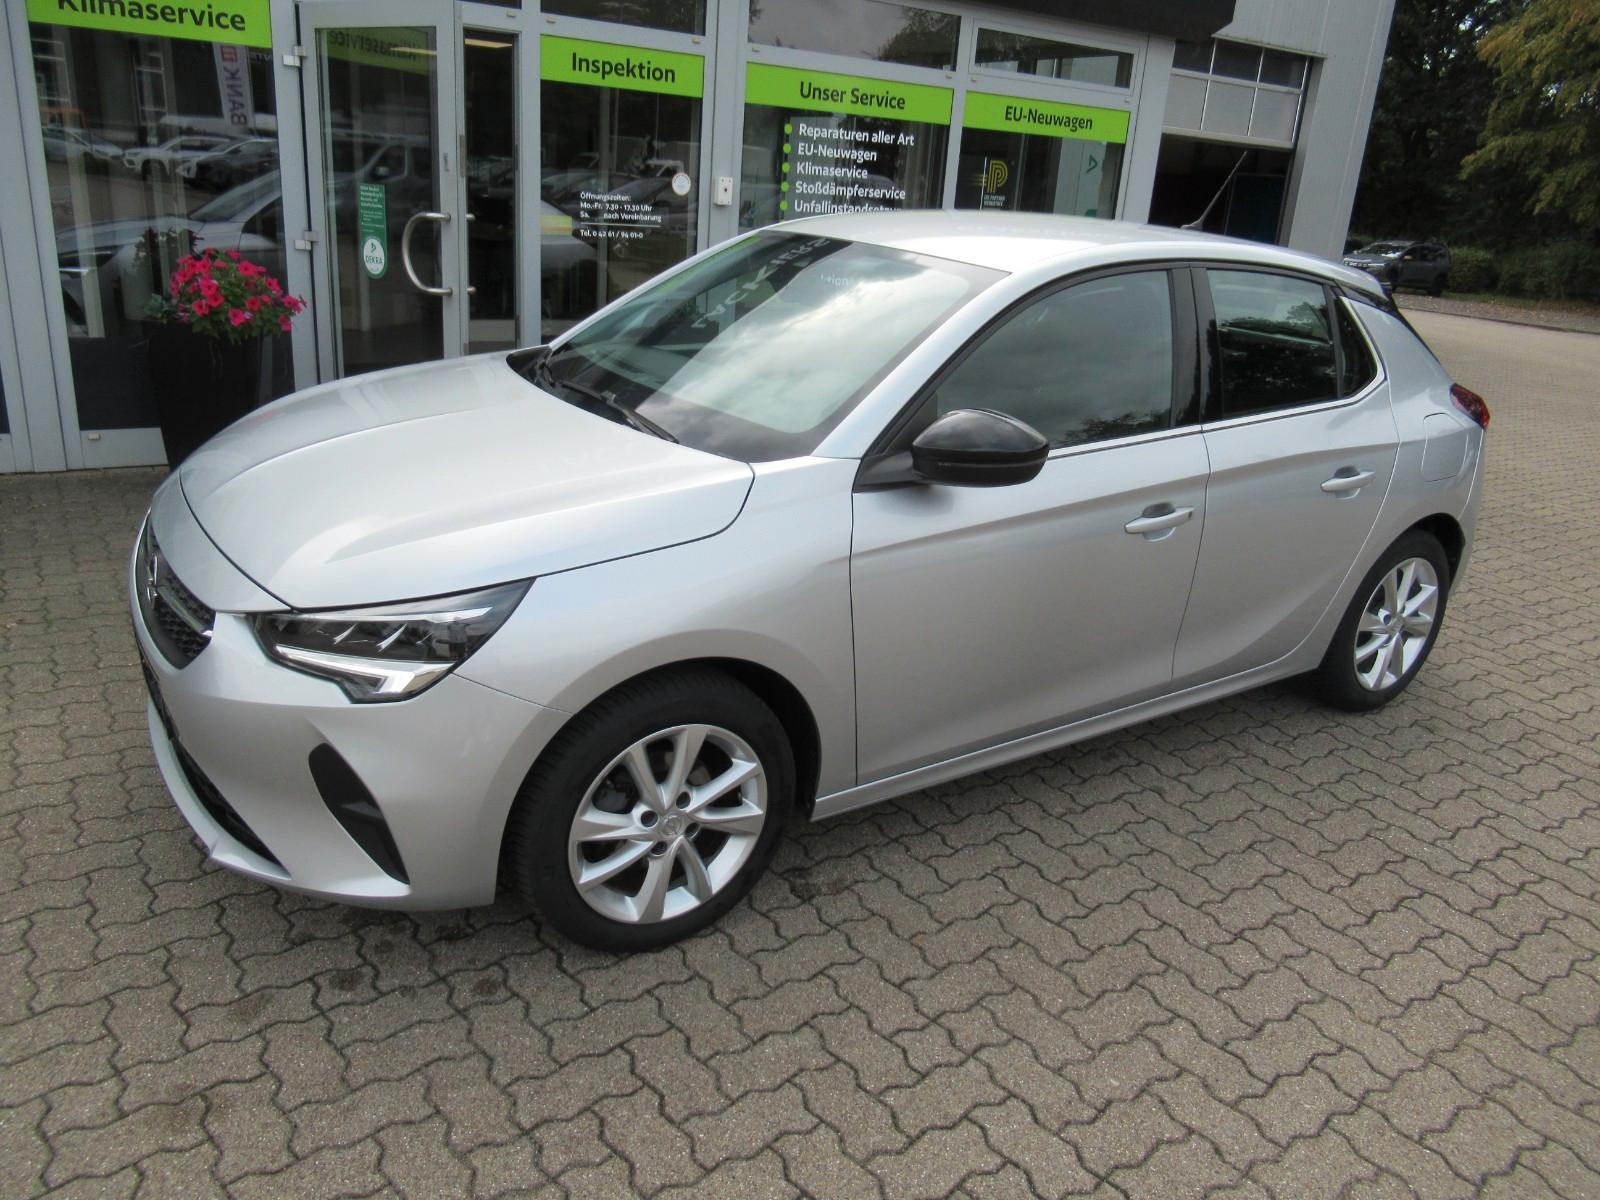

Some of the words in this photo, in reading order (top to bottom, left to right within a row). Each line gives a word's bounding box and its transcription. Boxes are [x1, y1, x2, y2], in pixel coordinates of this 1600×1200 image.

[571, 52, 676, 84] Inspektion
[799, 81, 846, 104] Unser
[850, 86, 906, 110] Service
[1005, 105, 1093, 133] EU-Neuwagen
[799, 123, 869, 142] Reparaturen
[871, 129, 895, 144] aller
[897, 132, 915, 146] Art
[798, 143, 877, 163] EU-Neuwagen
[796, 162, 868, 178] Klimaservice
[580, 191, 631, 201] Öffnungszeiten:
[795, 180, 906, 201] Stoßdämpferservice
[603, 212, 619, 220] nach
[620, 213, 661, 223] Vereinbarung
[580, 229, 591, 237] Tel.
[365, 255, 383, 265] DEKRA
